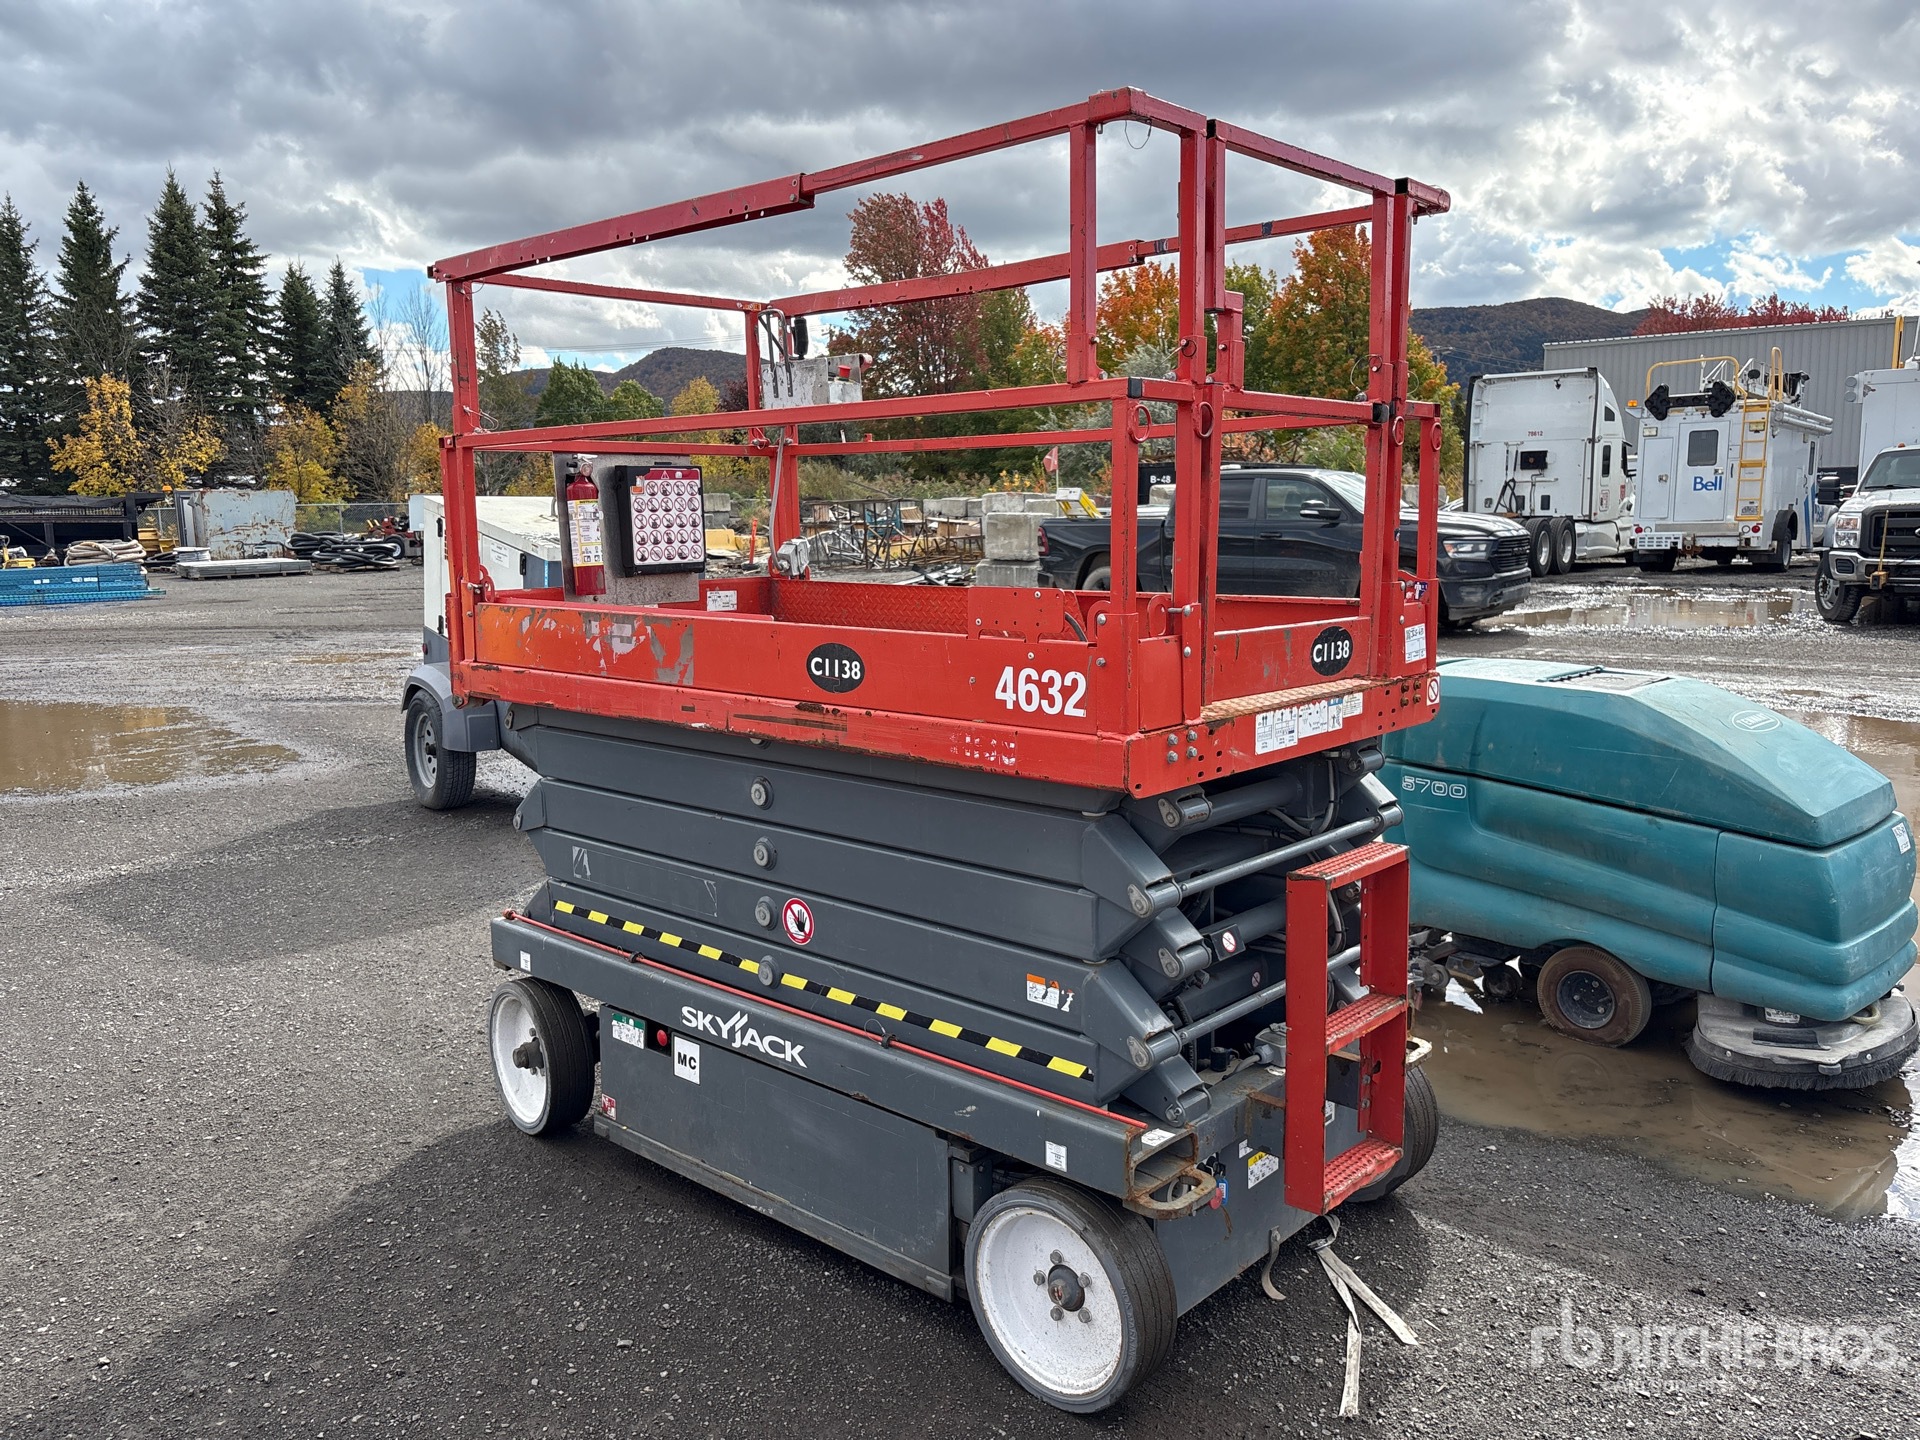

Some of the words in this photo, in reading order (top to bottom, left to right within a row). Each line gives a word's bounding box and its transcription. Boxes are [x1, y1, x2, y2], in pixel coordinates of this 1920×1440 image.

[1693, 475, 1722, 491] Bell
[1312, 639, 1350, 663] C1138
[810, 656, 861, 680] C1138
[995, 665, 1087, 718] 4632
[1401, 775, 1467, 799] 5700
[681, 1005, 808, 1069] SKYJACK
[677, 1051, 698, 1070] MC
